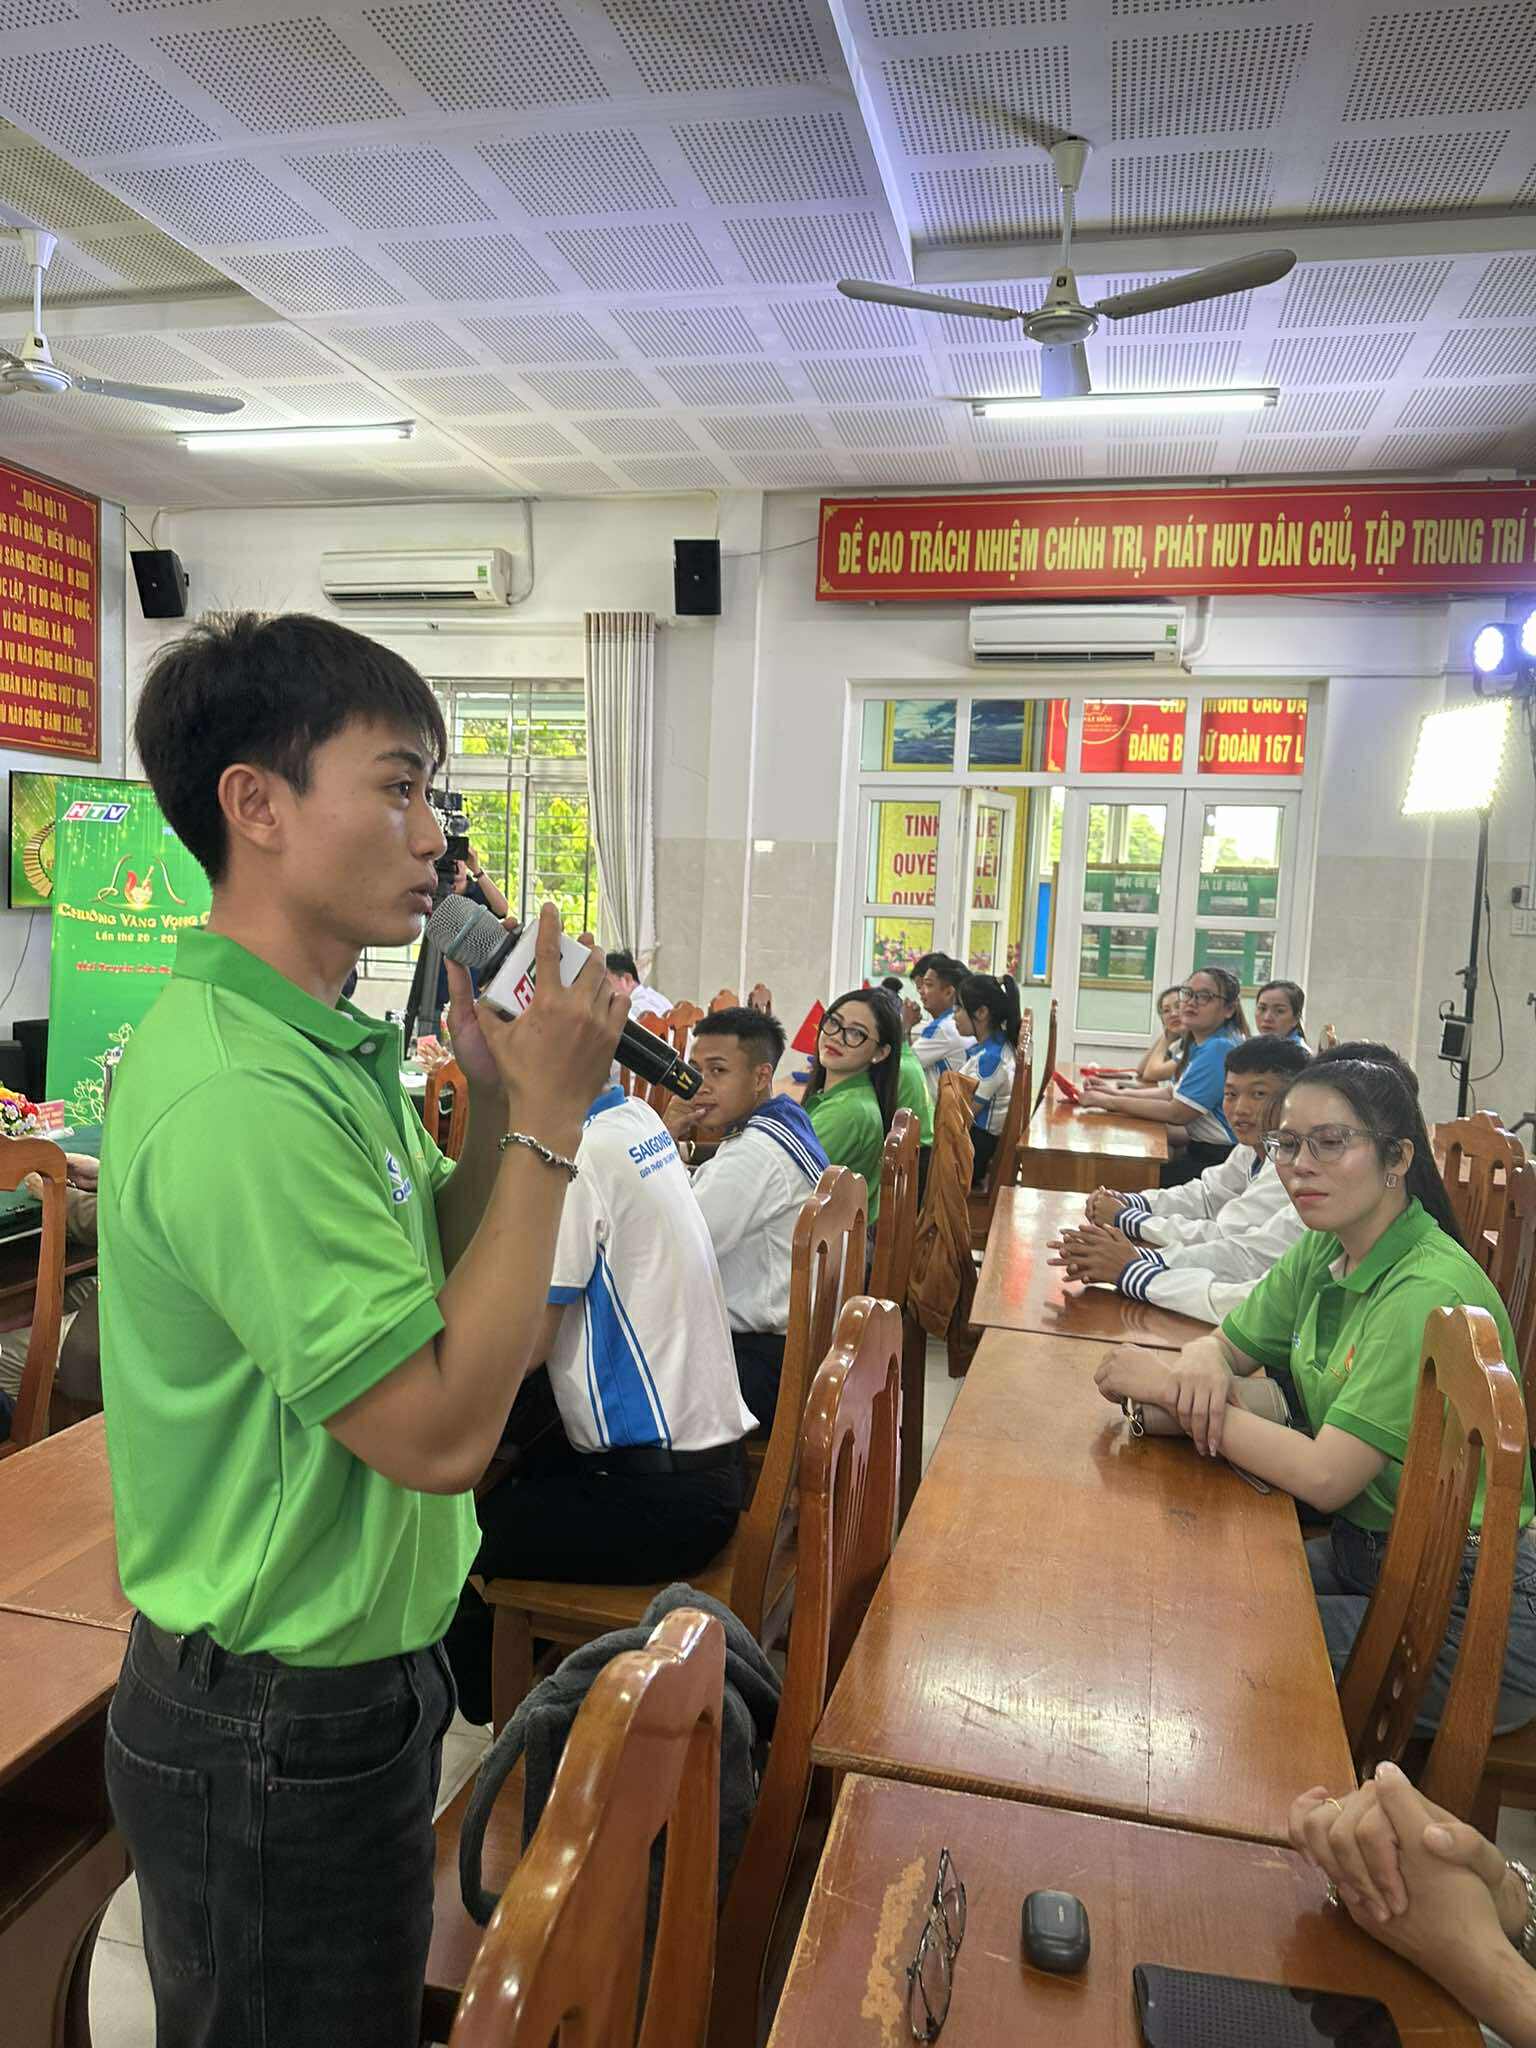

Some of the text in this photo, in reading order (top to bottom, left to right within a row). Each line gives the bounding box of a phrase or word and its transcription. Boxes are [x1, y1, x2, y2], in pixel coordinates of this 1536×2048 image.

[838, 517, 863, 574] ĐỀ
[867, 530, 904, 574] CAO
[910, 521, 971, 573] TRÁCH
[974, 519, 1040, 581] NHIỆM
[1044, 516, 1106, 571] CHÍNH
[1112, 525, 1147, 579] TRỊ,
[1153, 514, 1208, 568] PHÁT
[1211, 522, 1254, 567] HUY
[1257, 512, 1303, 567] DÂN
[1308, 505, 1357, 571] CHỦ,
[1365, 509, 1406, 576] TẬP
[1411, 517, 1485, 566] TRUNG
[1491, 506, 1529, 563] TRÍ
[1128, 723, 1169, 762] ĐẢNG
[1172, 733, 1183, 761] B
[1218, 728, 1261, 763] ĐOÀN
[1264, 734, 1293, 764] 167
[66, 802, 130, 821] HTV
[893, 847, 937, 878] QUYẾ
[120, 913, 157, 929] VÀNG
